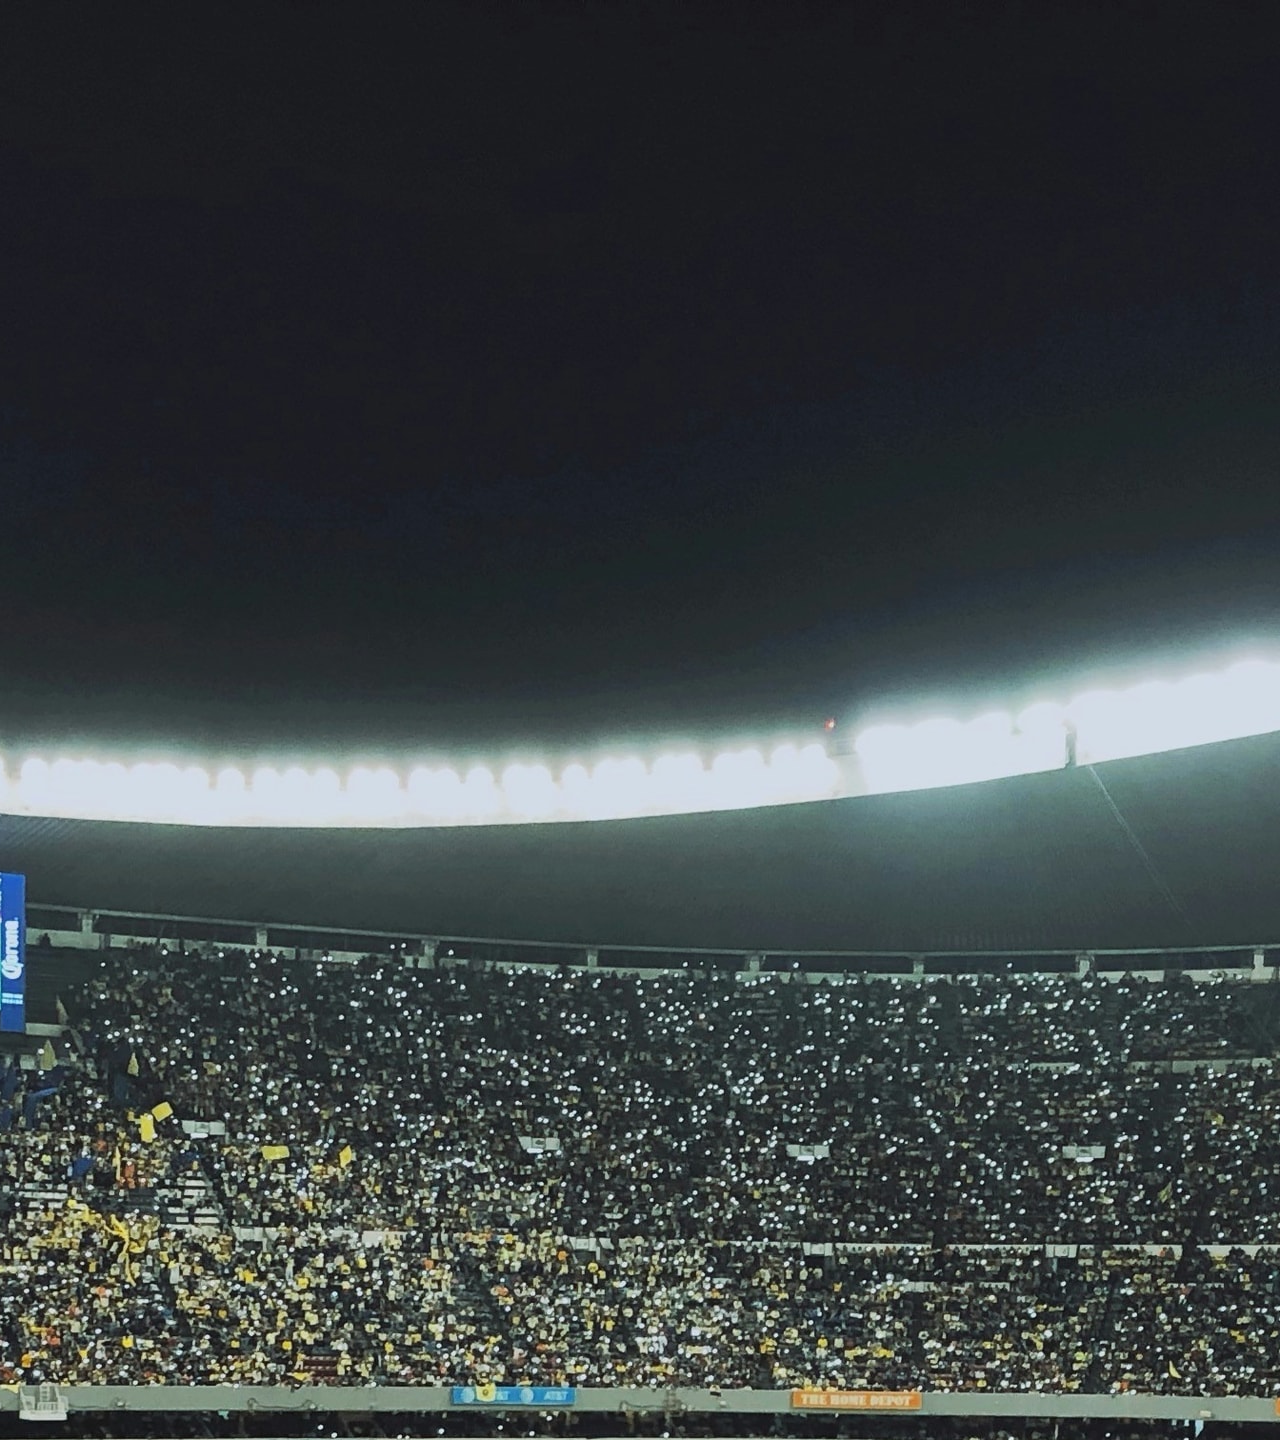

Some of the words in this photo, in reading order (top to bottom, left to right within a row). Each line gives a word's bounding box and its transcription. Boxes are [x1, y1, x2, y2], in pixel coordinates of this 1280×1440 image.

[801, 1394, 827, 1406] THE
[830, 1394, 867, 1406] HOME
[870, 1395, 913, 1406] DEPOT
